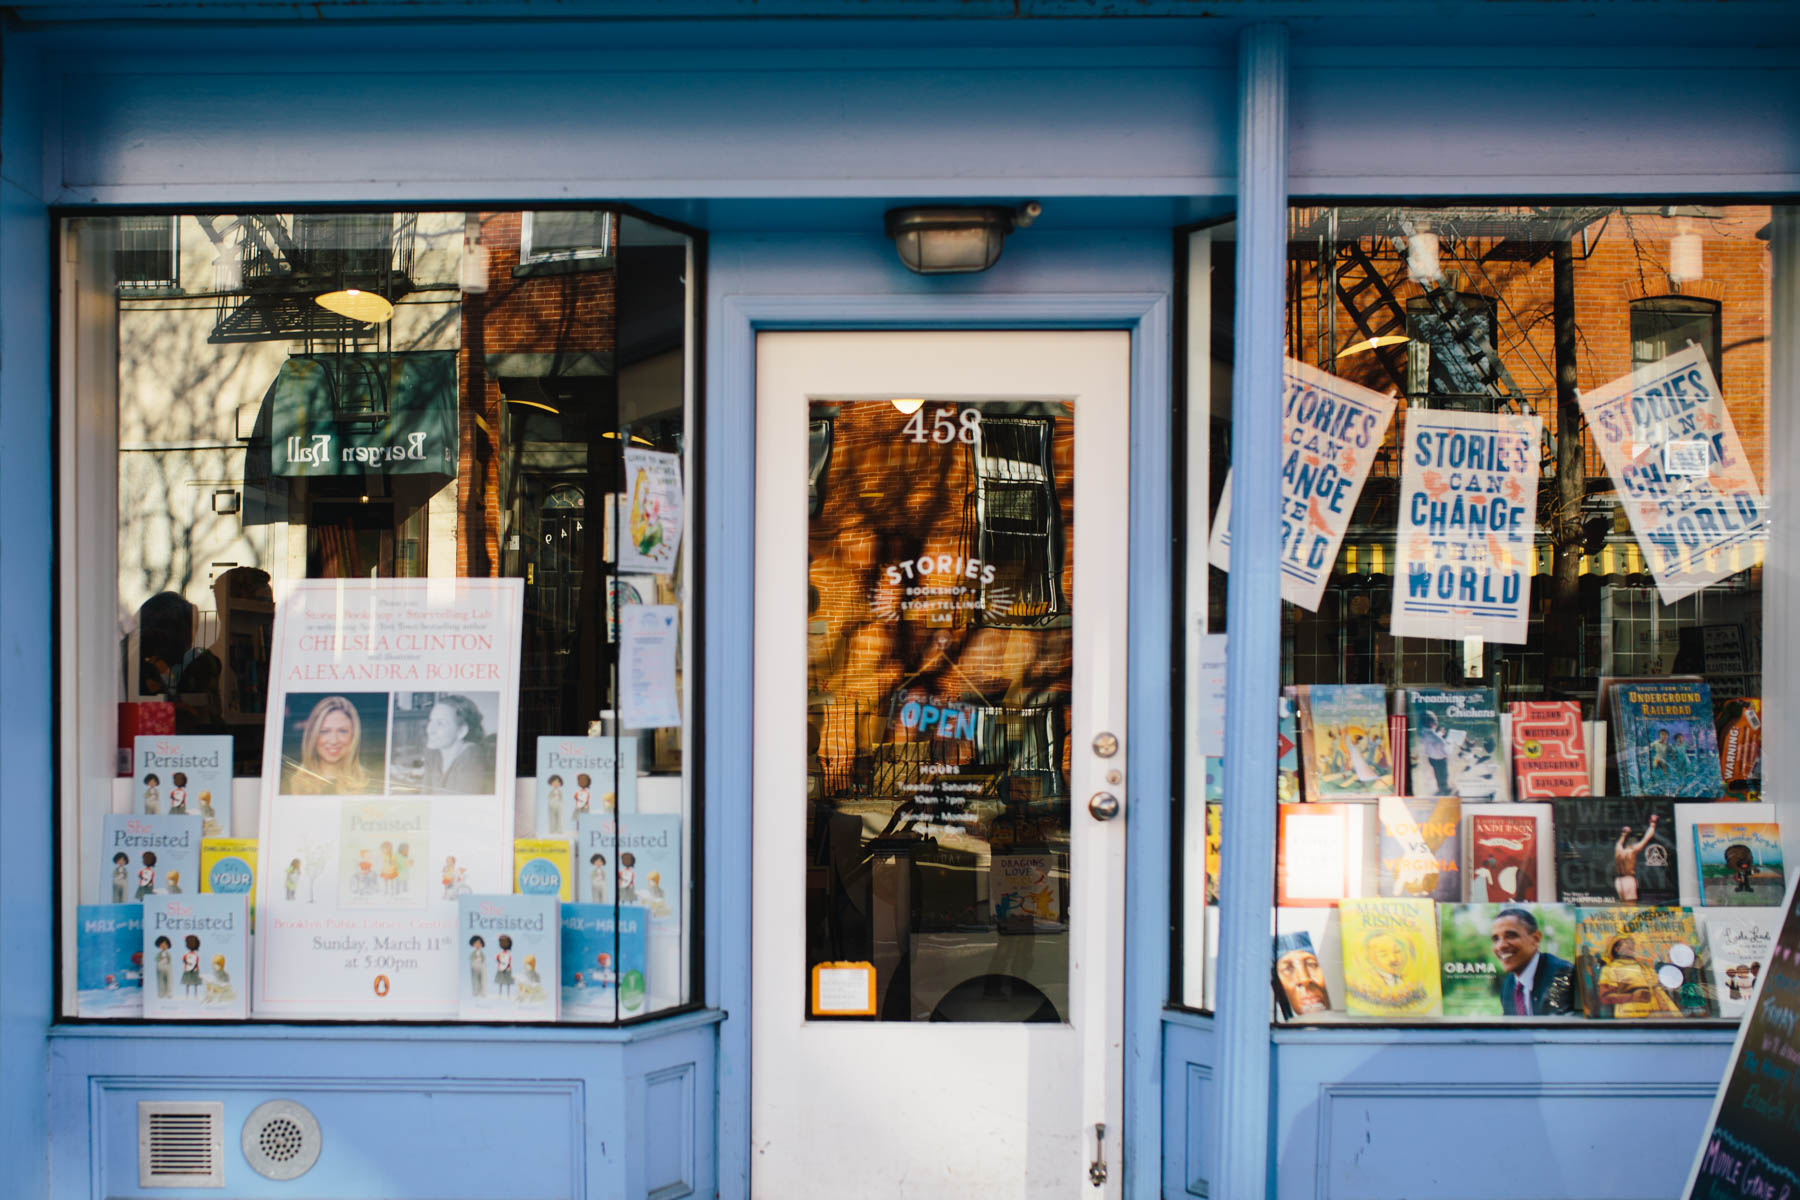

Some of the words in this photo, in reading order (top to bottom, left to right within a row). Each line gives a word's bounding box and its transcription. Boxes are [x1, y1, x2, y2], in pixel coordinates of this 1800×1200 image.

[1600, 368, 1711, 443] STORIES
[1283, 383, 1376, 448] TORIES
[902, 408, 983, 444] 458
[1291, 427, 1343, 461] CAN
[1415, 432, 1530, 473] STORIES
[1282, 449, 1352, 514] ANGE
[1450, 473, 1504, 493] CAN
[1411, 492, 1525, 542] CHANGE
[1648, 490, 1758, 563] WORLD
[1280, 519, 1329, 570] RLD
[1432, 541, 1488, 561] THE
[886, 554, 996, 585] STORIES
[906, 586, 966, 596] BOOKSHOP
[1408, 562, 1520, 604] WORLD
[901, 600, 985, 611] STORYTELLING
[931, 613, 952, 623] LAB
[395, 634, 494, 650] CLINTON
[288, 663, 419, 681] ALEXANDRA
[426, 663, 501, 681] BOIGER
[1411, 691, 1466, 708] Preaching
[1628, 691, 1701, 703] UNDERGROUND
[1446, 706, 1495, 718] Chickens
[1641, 703, 1692, 716] RAILROAD
[900, 701, 977, 741] OPEN
[144, 751, 219, 768] Persisted
[547, 752, 624, 769] Persisted
[1724, 726, 1740, 780] WARNING:
[919, 765, 960, 775] HOURS
[941, 782, 982, 793] Saturday
[350, 815, 421, 831] Persisted
[941, 812, 979, 823] Monday
[1385, 822, 1457, 837] LOVING
[1477, 823, 1533, 833] ANDERSON
[114, 831, 189, 847] Persisted
[1001, 858, 1045, 868] DRAGONS
[1383, 857, 1459, 872] VIRGINIA
[212, 872, 250, 885] YOUR
[521, 872, 559, 886] YOUR
[1005, 867, 1033, 876] LOVE
[167, 902, 192, 915] She
[480, 902, 504, 916] She
[1356, 903, 1419, 916] MARTIN
[84, 919, 115, 934] MAX
[155, 912, 233, 930] Persisted
[273, 919, 321, 930] Brooklyn
[469, 912, 543, 930] Persisted
[595, 918, 638, 934] MALA
[1362, 915, 1417, 928] RISING
[312, 936, 369, 951] Sunday,
[374, 936, 421, 951] March
[344, 958, 358, 969] at
[363, 956, 418, 974] 5:00pm
[1444, 961, 1497, 974] OBAMA
